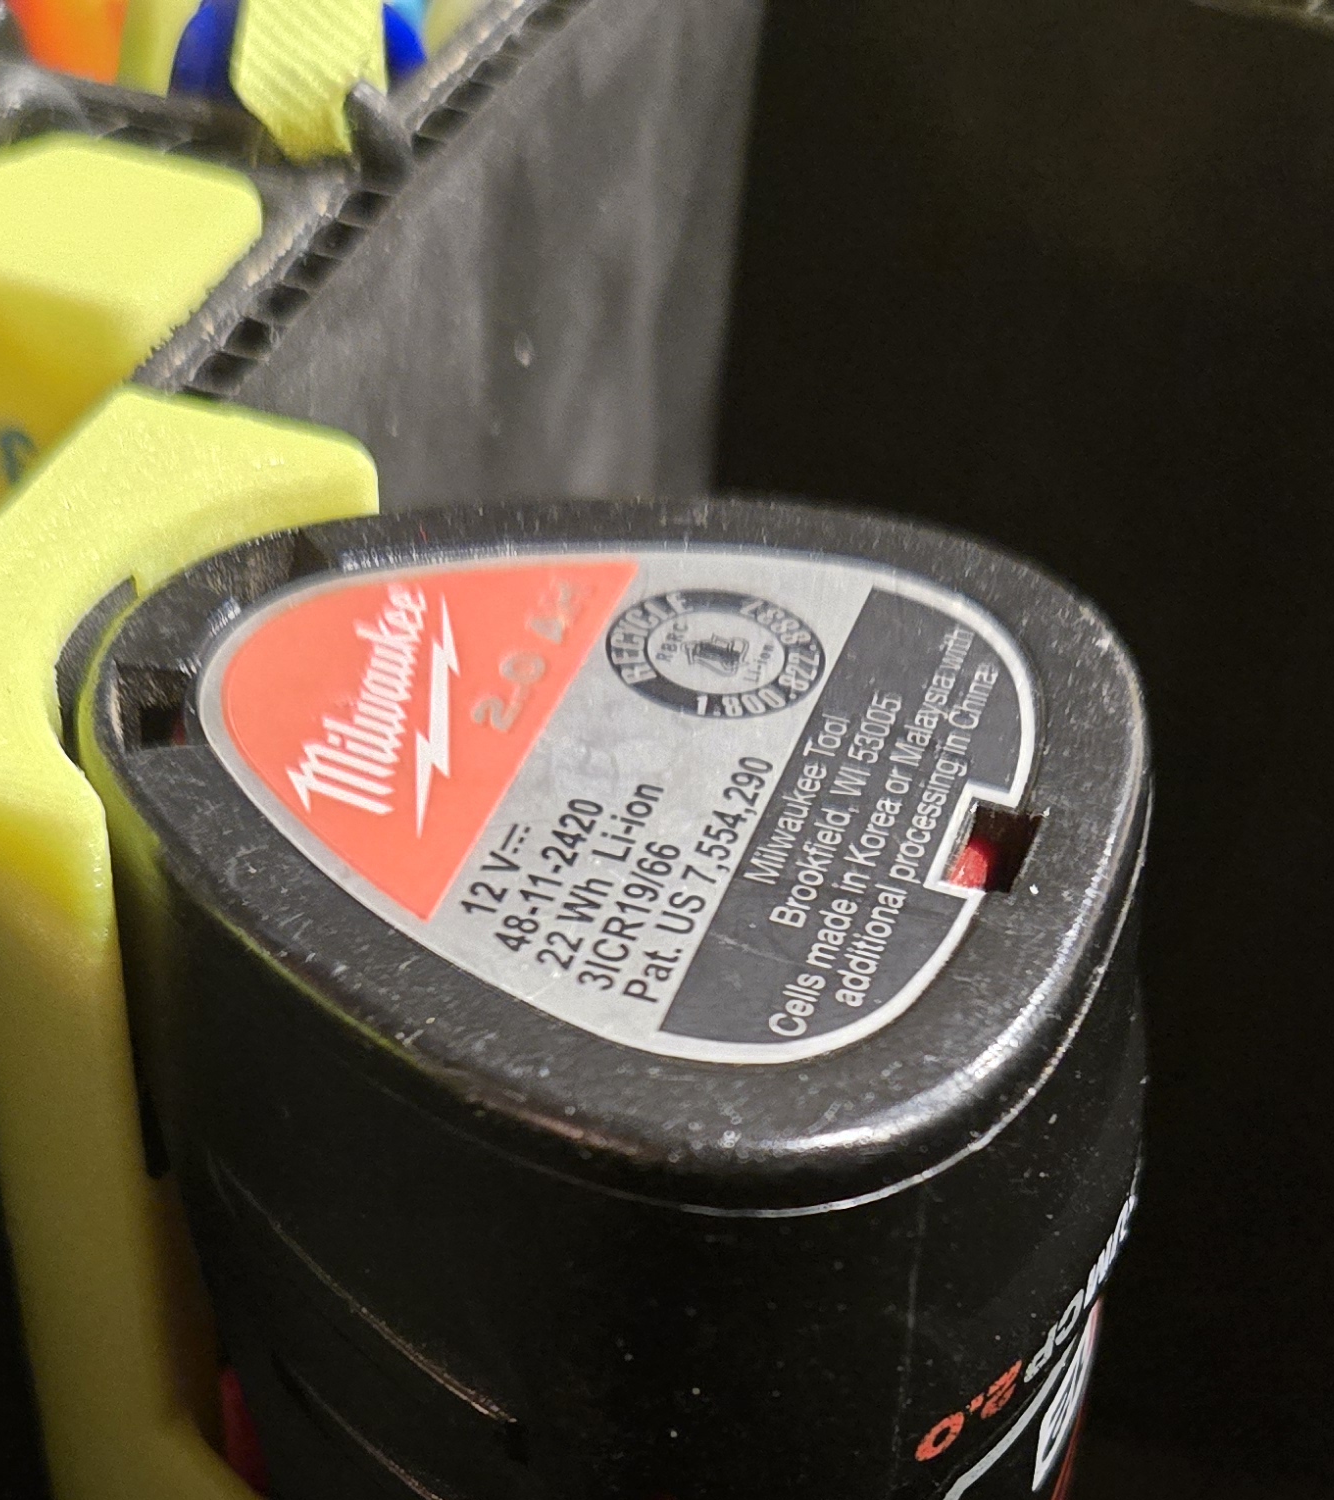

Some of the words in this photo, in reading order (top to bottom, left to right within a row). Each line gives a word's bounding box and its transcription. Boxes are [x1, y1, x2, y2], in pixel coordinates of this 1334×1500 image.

[610, 592, 694, 684] RECYCLE
[939, 624, 975, 672] with
[285, 583, 428, 816] Milwaukee
[847, 690, 903, 764] 53005
[889, 673, 957, 767] Malaysia
[948, 661, 999, 730] China
[885, 765, 913, 795] or
[935, 732, 971, 757] in
[743, 756, 827, 885] Milwaukee
[803, 713, 850, 757] Tool
[830, 766, 871, 796] WI
[592, 783, 665, 862] Li-ion
[844, 798, 903, 867] Korea
[889, 756, 969, 884] processing
[461, 881, 508, 915] 12
[495, 798, 604, 952] 48-11-2420
[557, 877, 615, 924] Wh
[623, 947, 684, 1003] Pat.
[656, 891, 706, 935] US
[681, 756, 774, 885] 7,554,290
[769, 807, 860, 928] Brookfield,
[832, 868, 871, 894] in
[537, 931, 583, 971] 22
[577, 841, 681, 991] 3ICR19/66
[805, 898, 858, 969] made
[835, 883, 908, 1007] additional
[768, 971, 826, 1037] Cells
